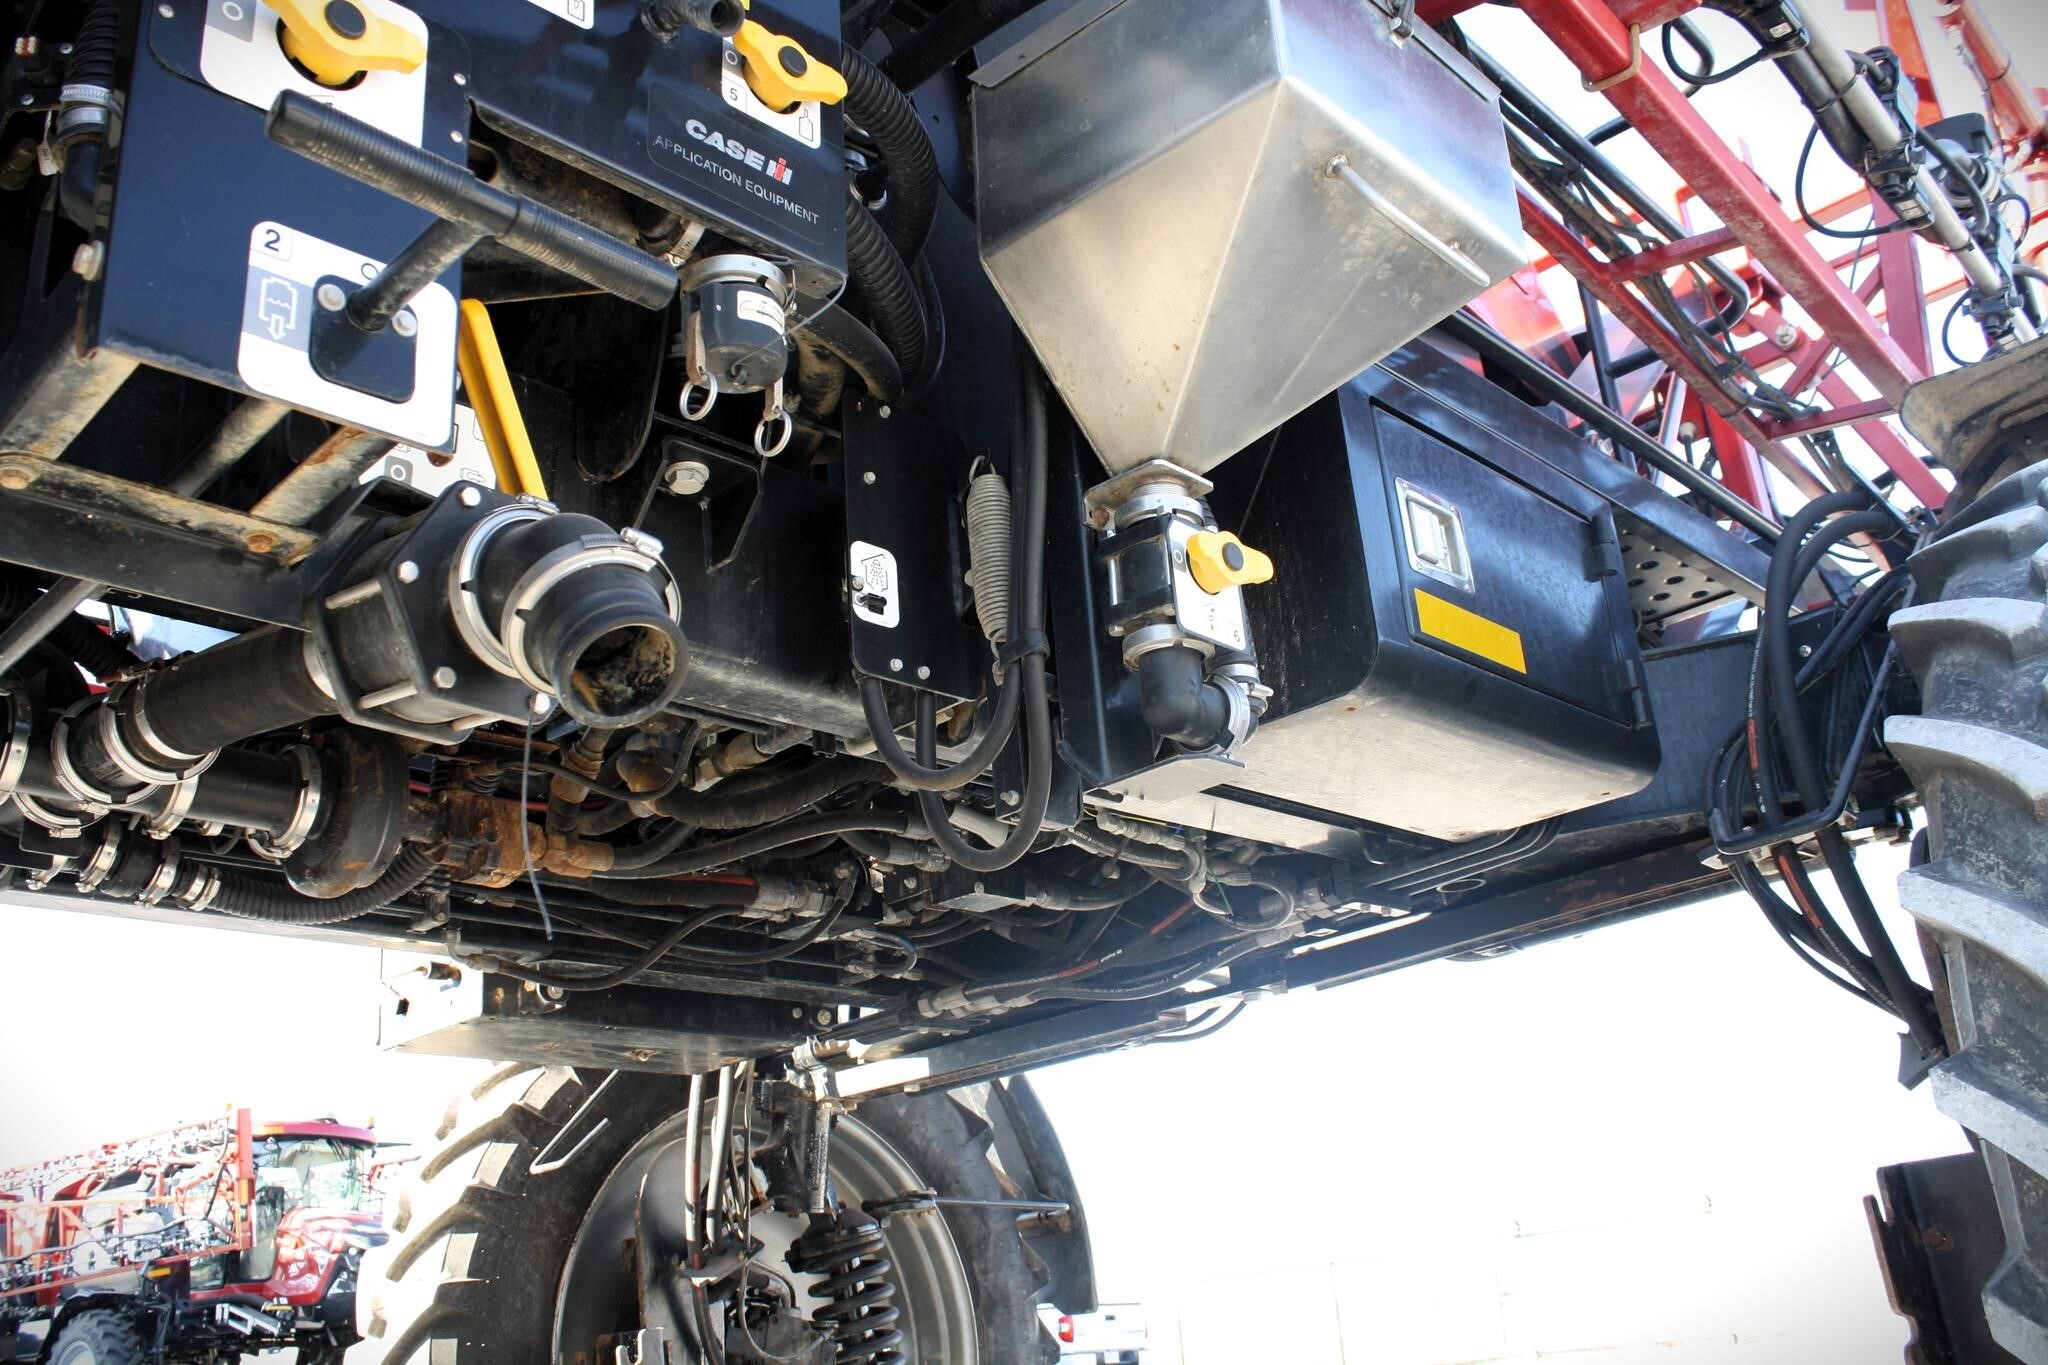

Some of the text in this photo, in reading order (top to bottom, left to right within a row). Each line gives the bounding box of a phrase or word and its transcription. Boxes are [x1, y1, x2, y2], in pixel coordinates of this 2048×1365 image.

[729, 87, 738, 102] 5
[685, 118, 766, 172] CASE
[655, 134, 819, 225] APPLICATION EQUIPMENT
[264, 228, 281, 252] 2
